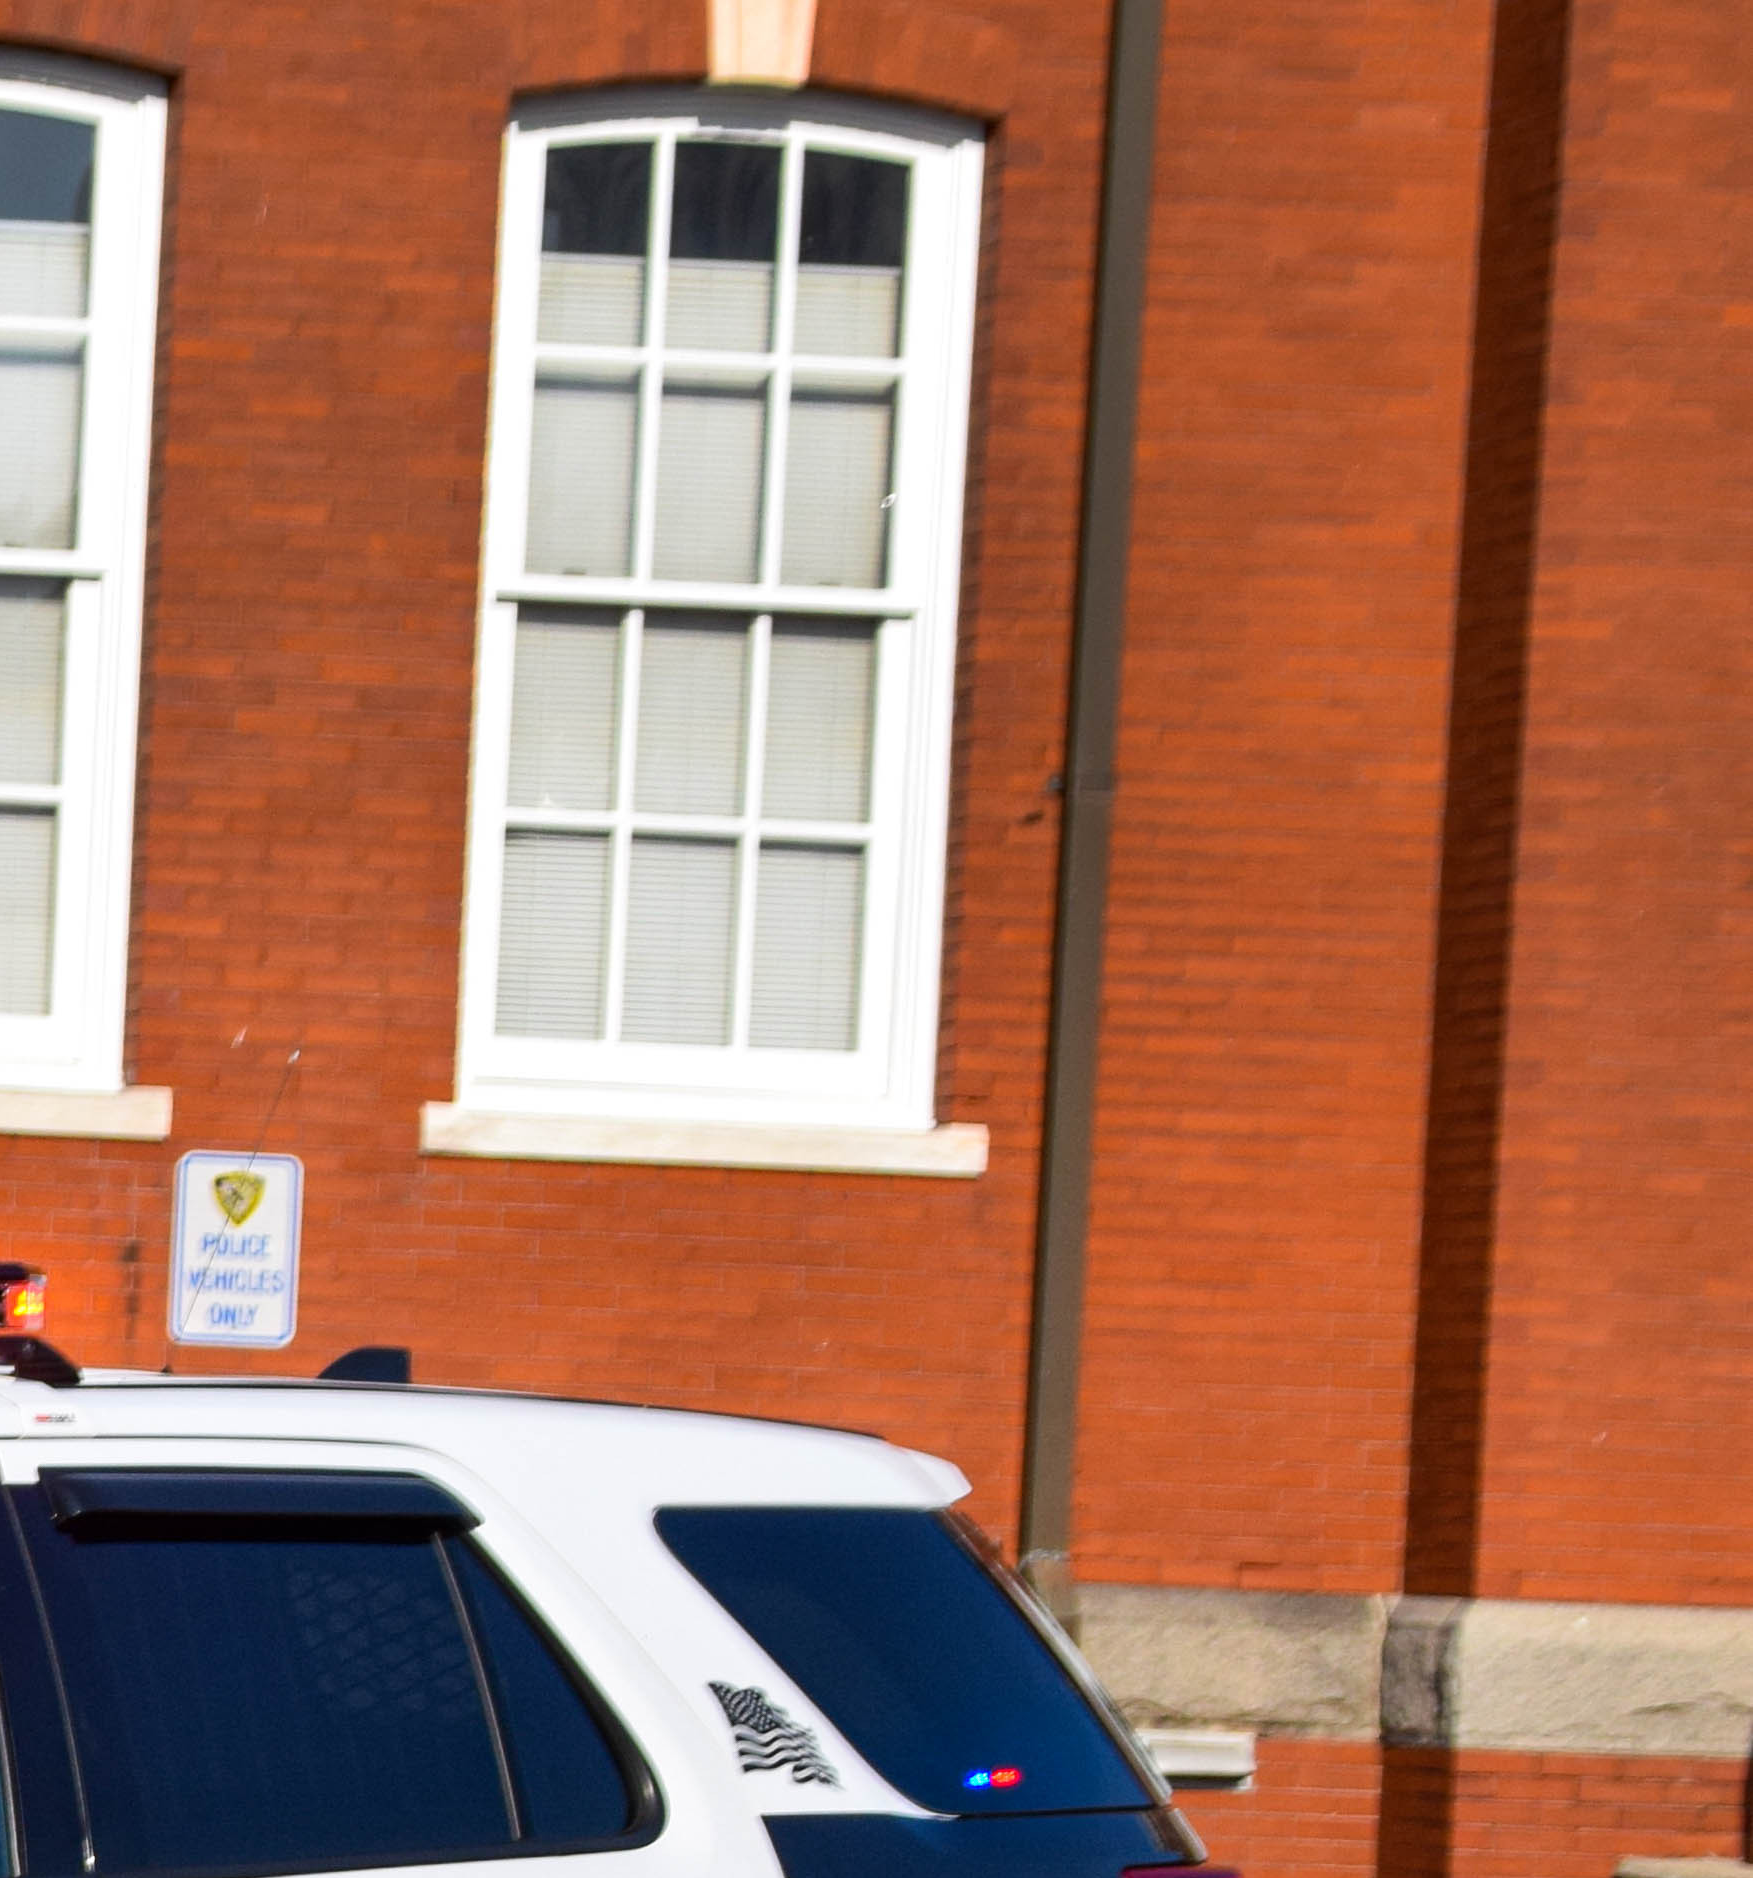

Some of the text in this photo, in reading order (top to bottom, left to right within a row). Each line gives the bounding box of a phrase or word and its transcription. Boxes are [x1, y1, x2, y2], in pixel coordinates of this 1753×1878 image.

[202, 1233, 272, 1259] POLICE
[190, 1269, 285, 1296] VEHICLES
[210, 1302, 258, 1327] ONLY
